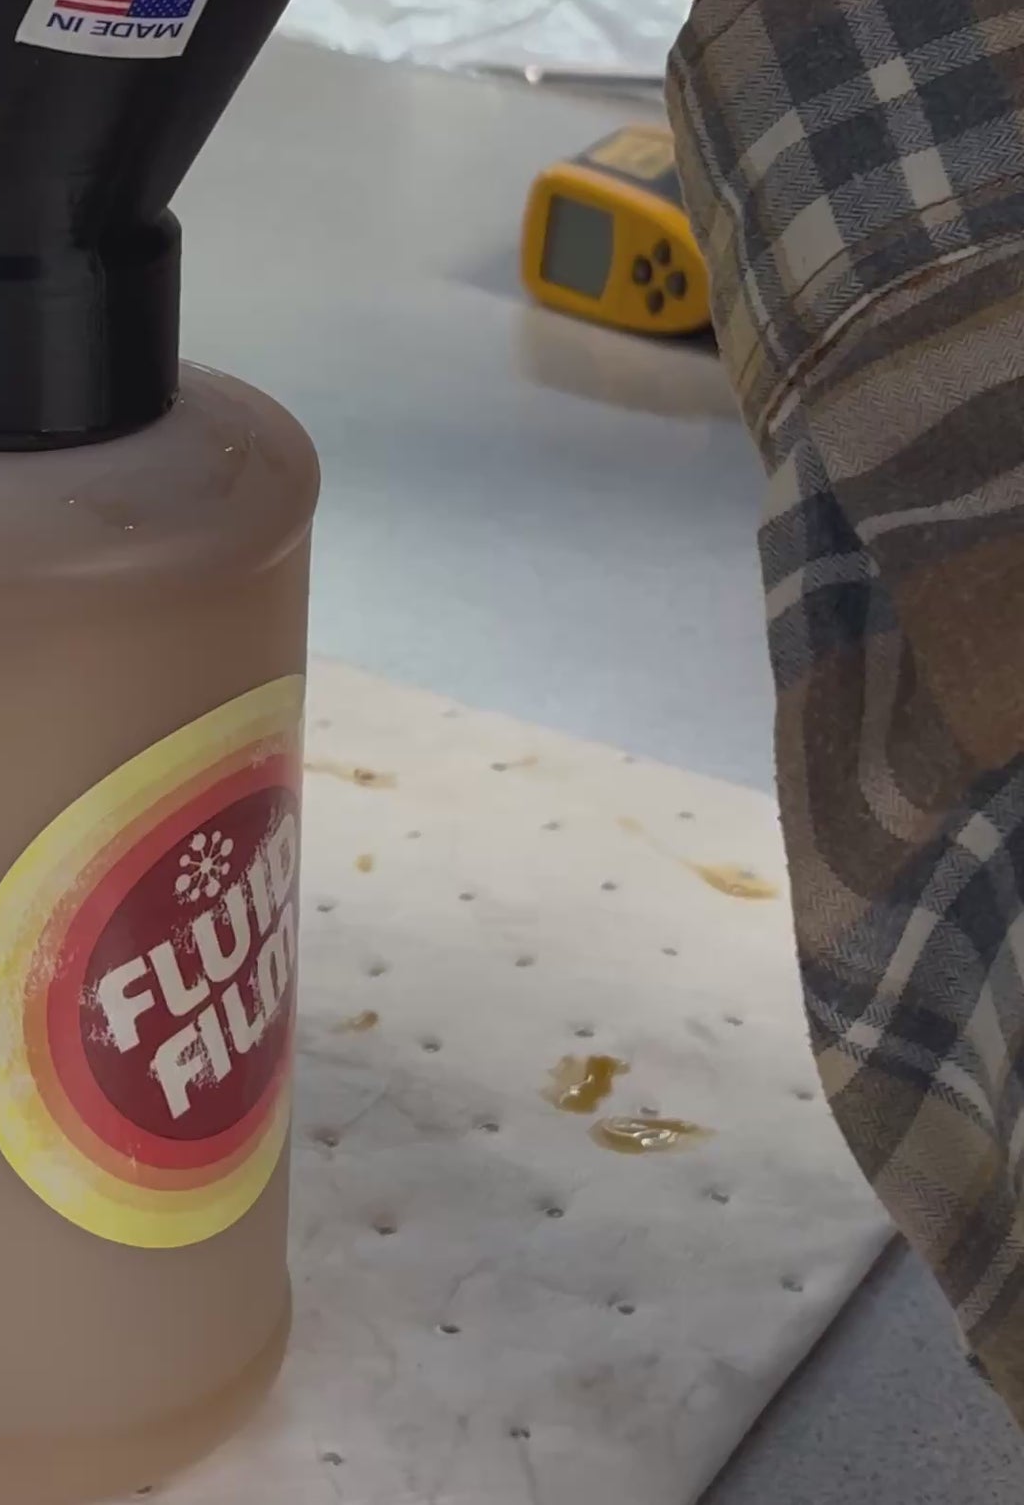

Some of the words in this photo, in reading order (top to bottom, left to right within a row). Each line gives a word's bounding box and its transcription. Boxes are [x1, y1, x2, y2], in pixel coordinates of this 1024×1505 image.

[46, 11, 86, 33] IN
[89, 19, 184, 39] MADE
[97, 812, 297, 1055] FLUID
